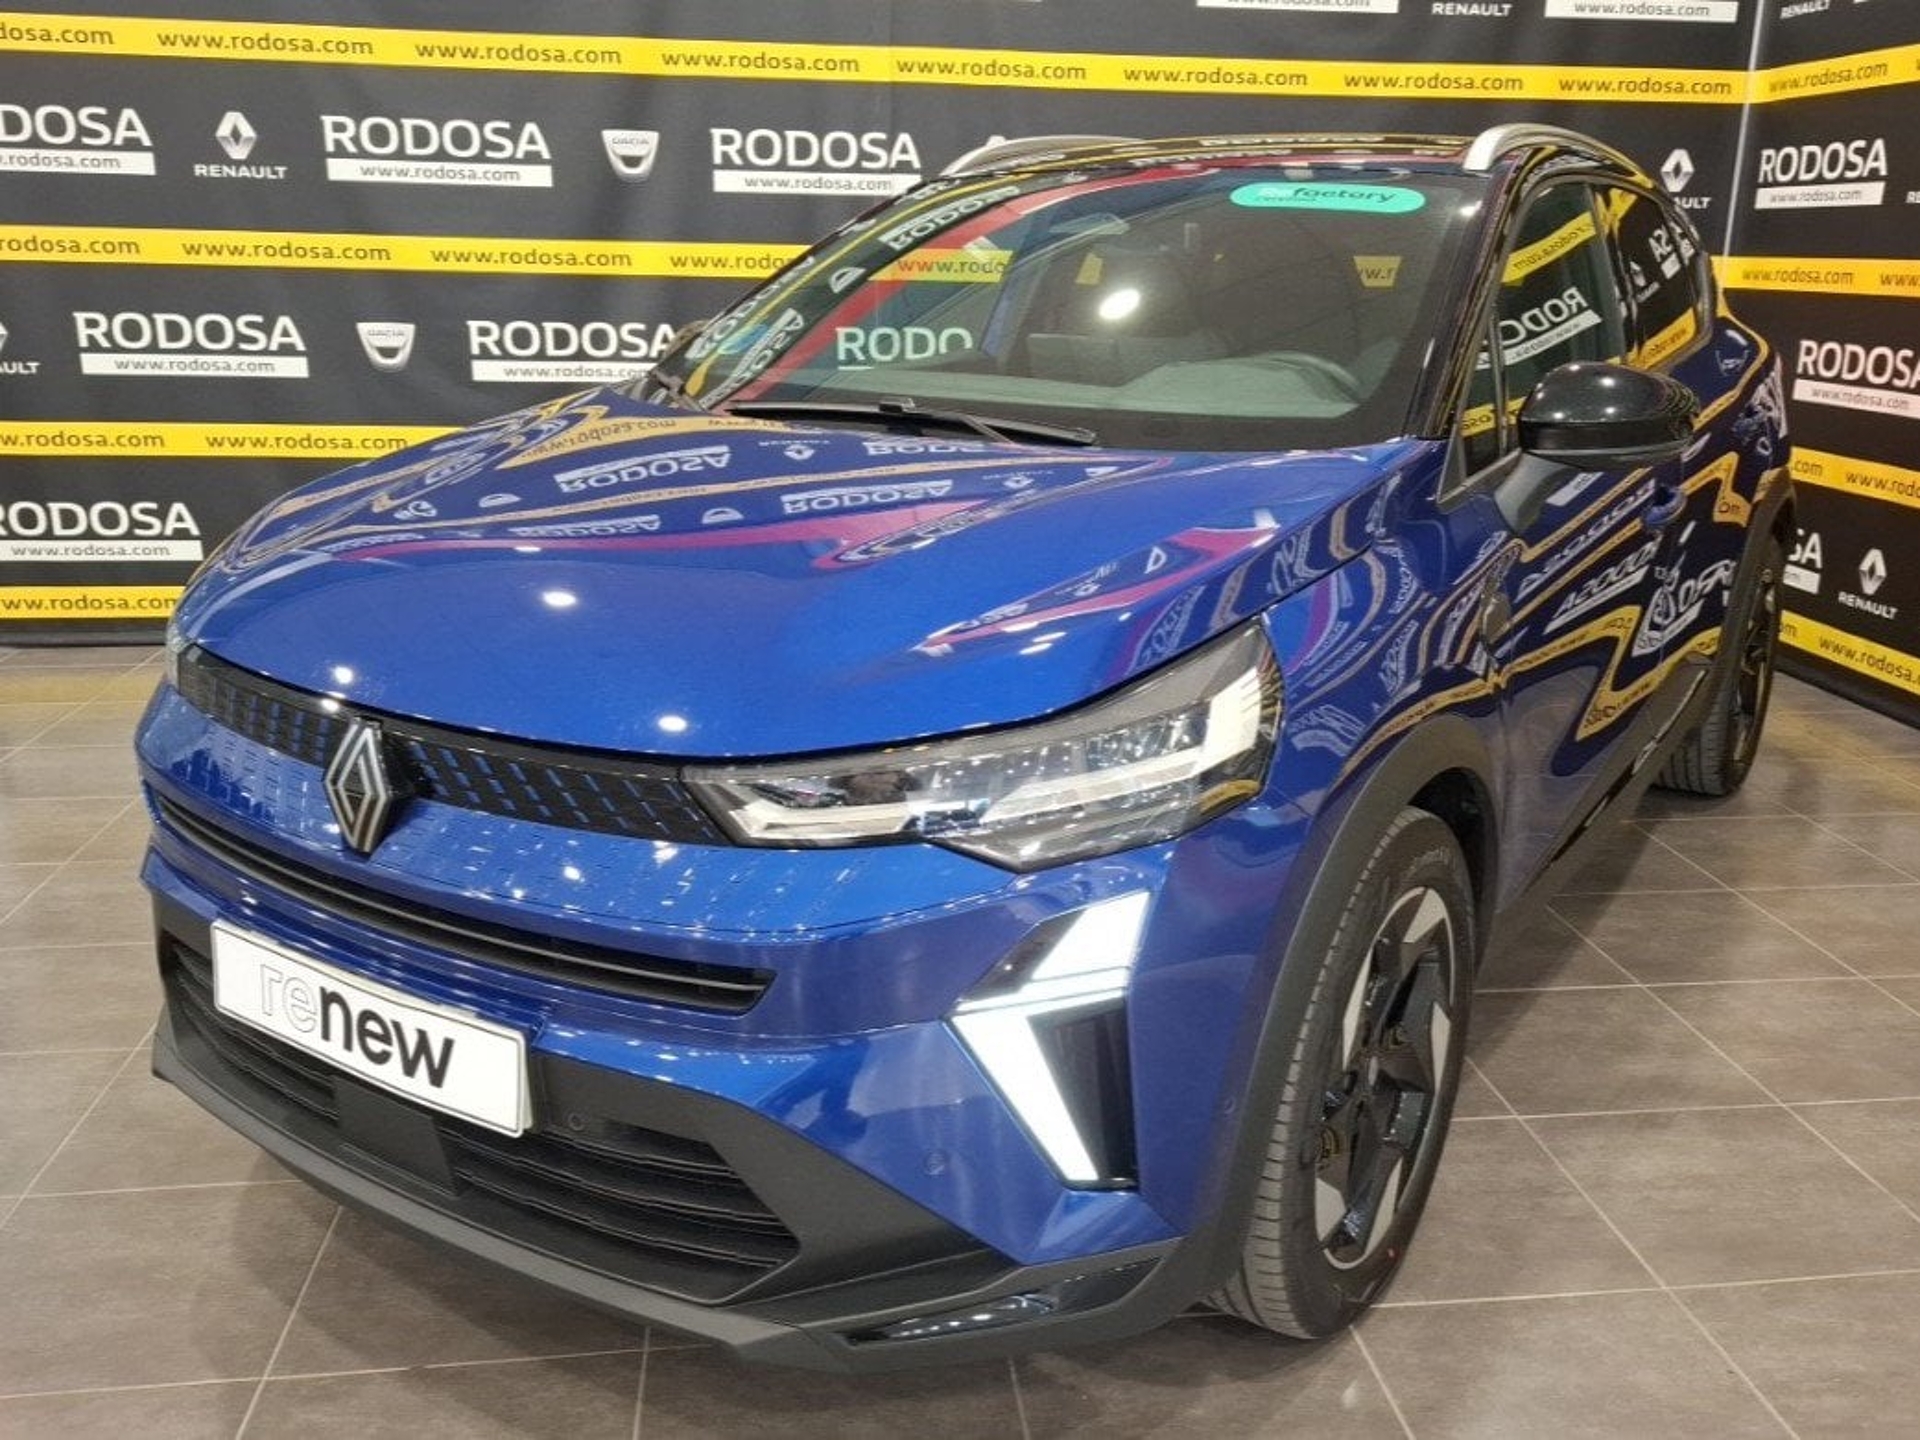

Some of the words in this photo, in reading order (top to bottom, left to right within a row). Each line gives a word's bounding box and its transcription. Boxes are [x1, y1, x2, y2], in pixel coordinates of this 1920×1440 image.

[1431, 2, 1512, 16] RENAULT
[1574, 1, 1710, 16] www.rodosa.com
[157, 30, 374, 55] www.rodosa.com
[415, 42, 622, 66] www.rodosa.com
[662, 50, 860, 73] www.rodosa.com
[897, 58, 1087, 81] www.rodosa.com
[1123, 65, 1308, 88] www.rodosa.com
[1770, 62, 1888, 92] www.rodosa.com
[1344, 72, 1524, 92] www.rodosa.com
[1559, 76, 1732, 96] www.rodosa.com
[320, 114, 551, 160] RODOSA
[710, 128, 921, 170] RODOSA
[0, 153, 121, 169] .rodosa.com
[1758, 138, 1888, 183] RODOSA
[194, 163, 287, 179] RENAULT
[360, 163, 521, 183] www.rodosa.com
[744, 176, 892, 192] www.rodosa.com
[182, 242, 391, 262] www.rodosa.com
[431, 248, 633, 267] www.rodosa.com
[670, 255, 796, 269] www.rodo
[1742, 268, 1855, 285] www.rodosa.com
[72, 311, 306, 352] RODOSA
[467, 320, 676, 359] RODOSA
[114, 356, 276, 374] www.rodosa.com
[0, 431, 165, 448] w.rodosa.com
[205, 433, 408, 449] www.rodosa.com
[0, 501, 200, 537] ODOSA
[11, 545, 171, 556] www.rodosa.com
[1838, 591, 1899, 620] RENAULT
[1819, 636, 1920, 684] www.rodosa.
[259, 963, 455, 1089] renew
